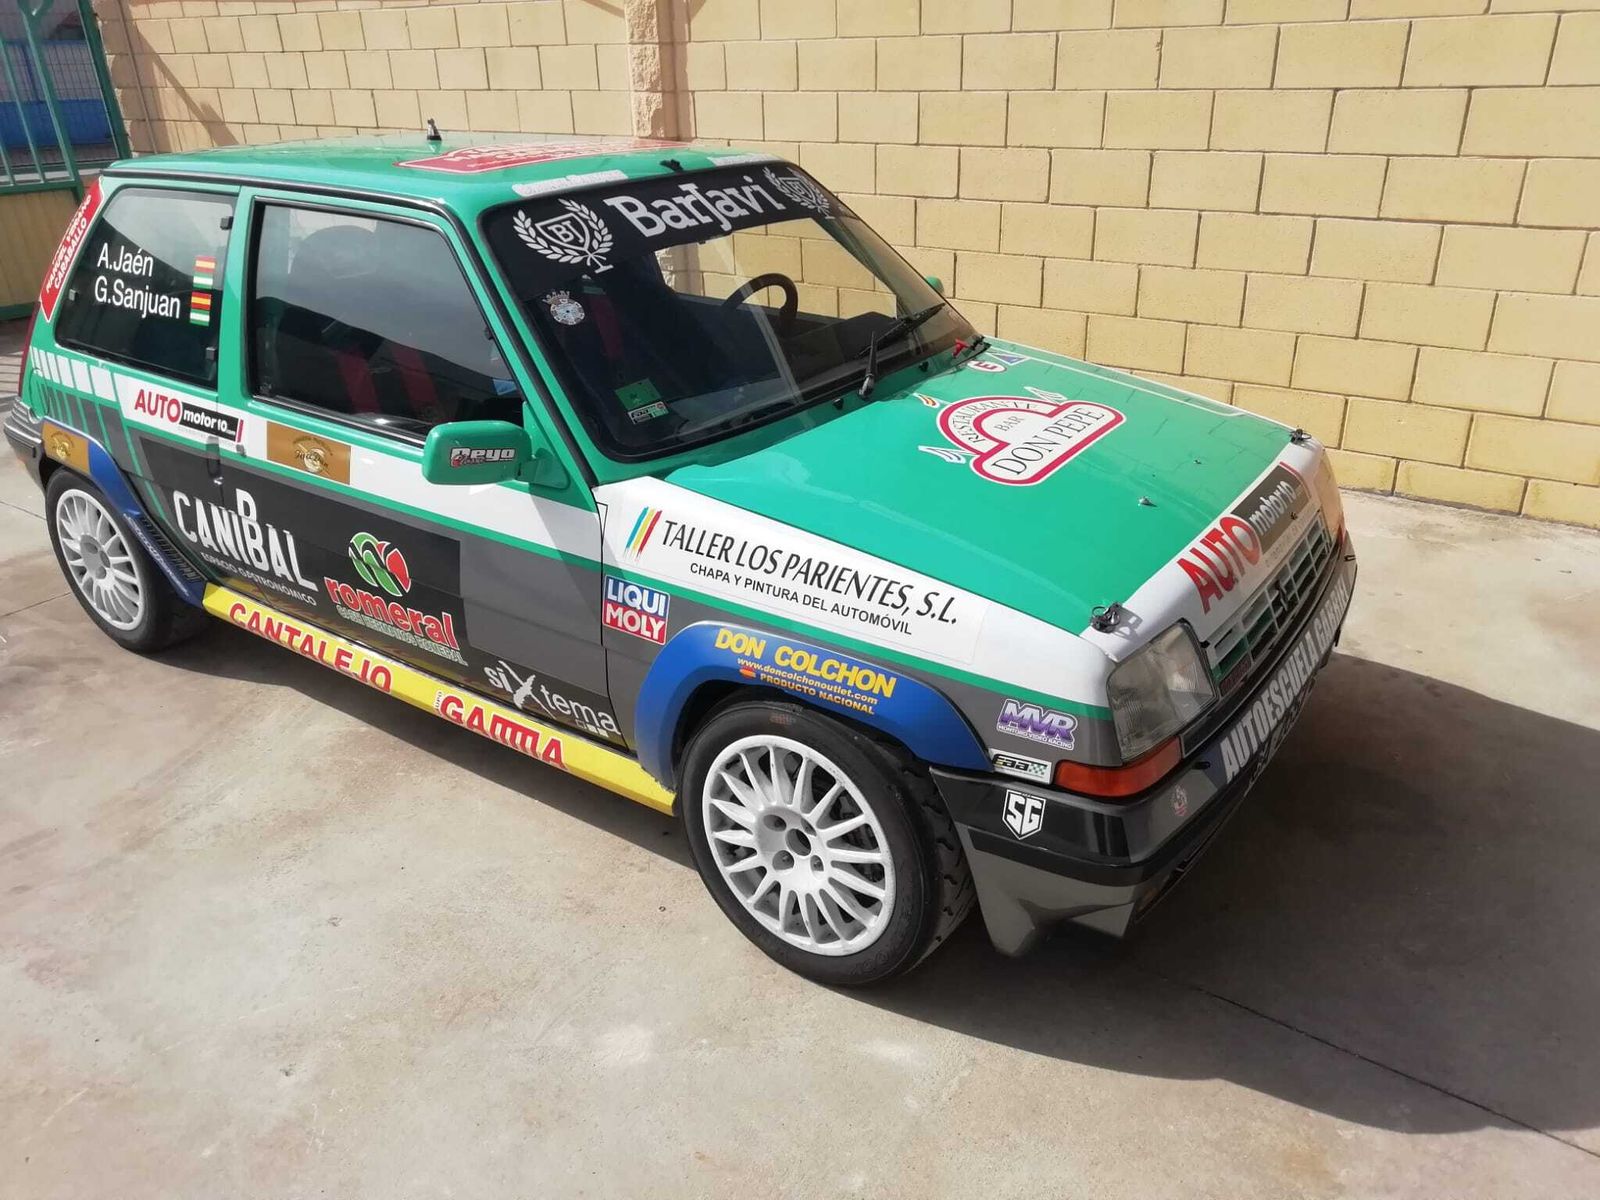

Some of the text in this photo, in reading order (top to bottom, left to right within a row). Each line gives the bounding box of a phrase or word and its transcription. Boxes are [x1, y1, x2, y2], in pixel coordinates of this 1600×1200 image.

[603, 175, 787, 237] BarJavi
[54, 217, 88, 290] CARABALLO
[97, 242, 154, 277] A.Jaén
[94, 275, 181, 319] G.Sanjuan
[134, 388, 181, 423] AUTO
[993, 415, 1025, 432] BAR
[991, 407, 1105, 475] DON PEPE
[173, 487, 319, 592] CANIBAL
[1176, 516, 1262, 615] AUTO
[607, 578, 667, 617] LIQUI
[662, 520, 957, 625] TALLER LOS PARIENTES, S.L.
[690, 562, 912, 635] CHAPA Y PINTURA DEL AUTOMÓVIL
[323, 576, 461, 651] romeral
[605, 602, 666, 640] MOLY
[229, 602, 392, 693] CANTALEJO
[714, 628, 897, 698] DON COLCHON
[737, 657, 878, 705] www.doncolchonoutlet.com
[760, 672, 875, 715] PRODUCTO NACIONAL
[1219, 630, 1320, 785] AUTOESCUELA
[1000, 702, 1075, 742] MVR
[1006, 793, 1043, 836] SG
